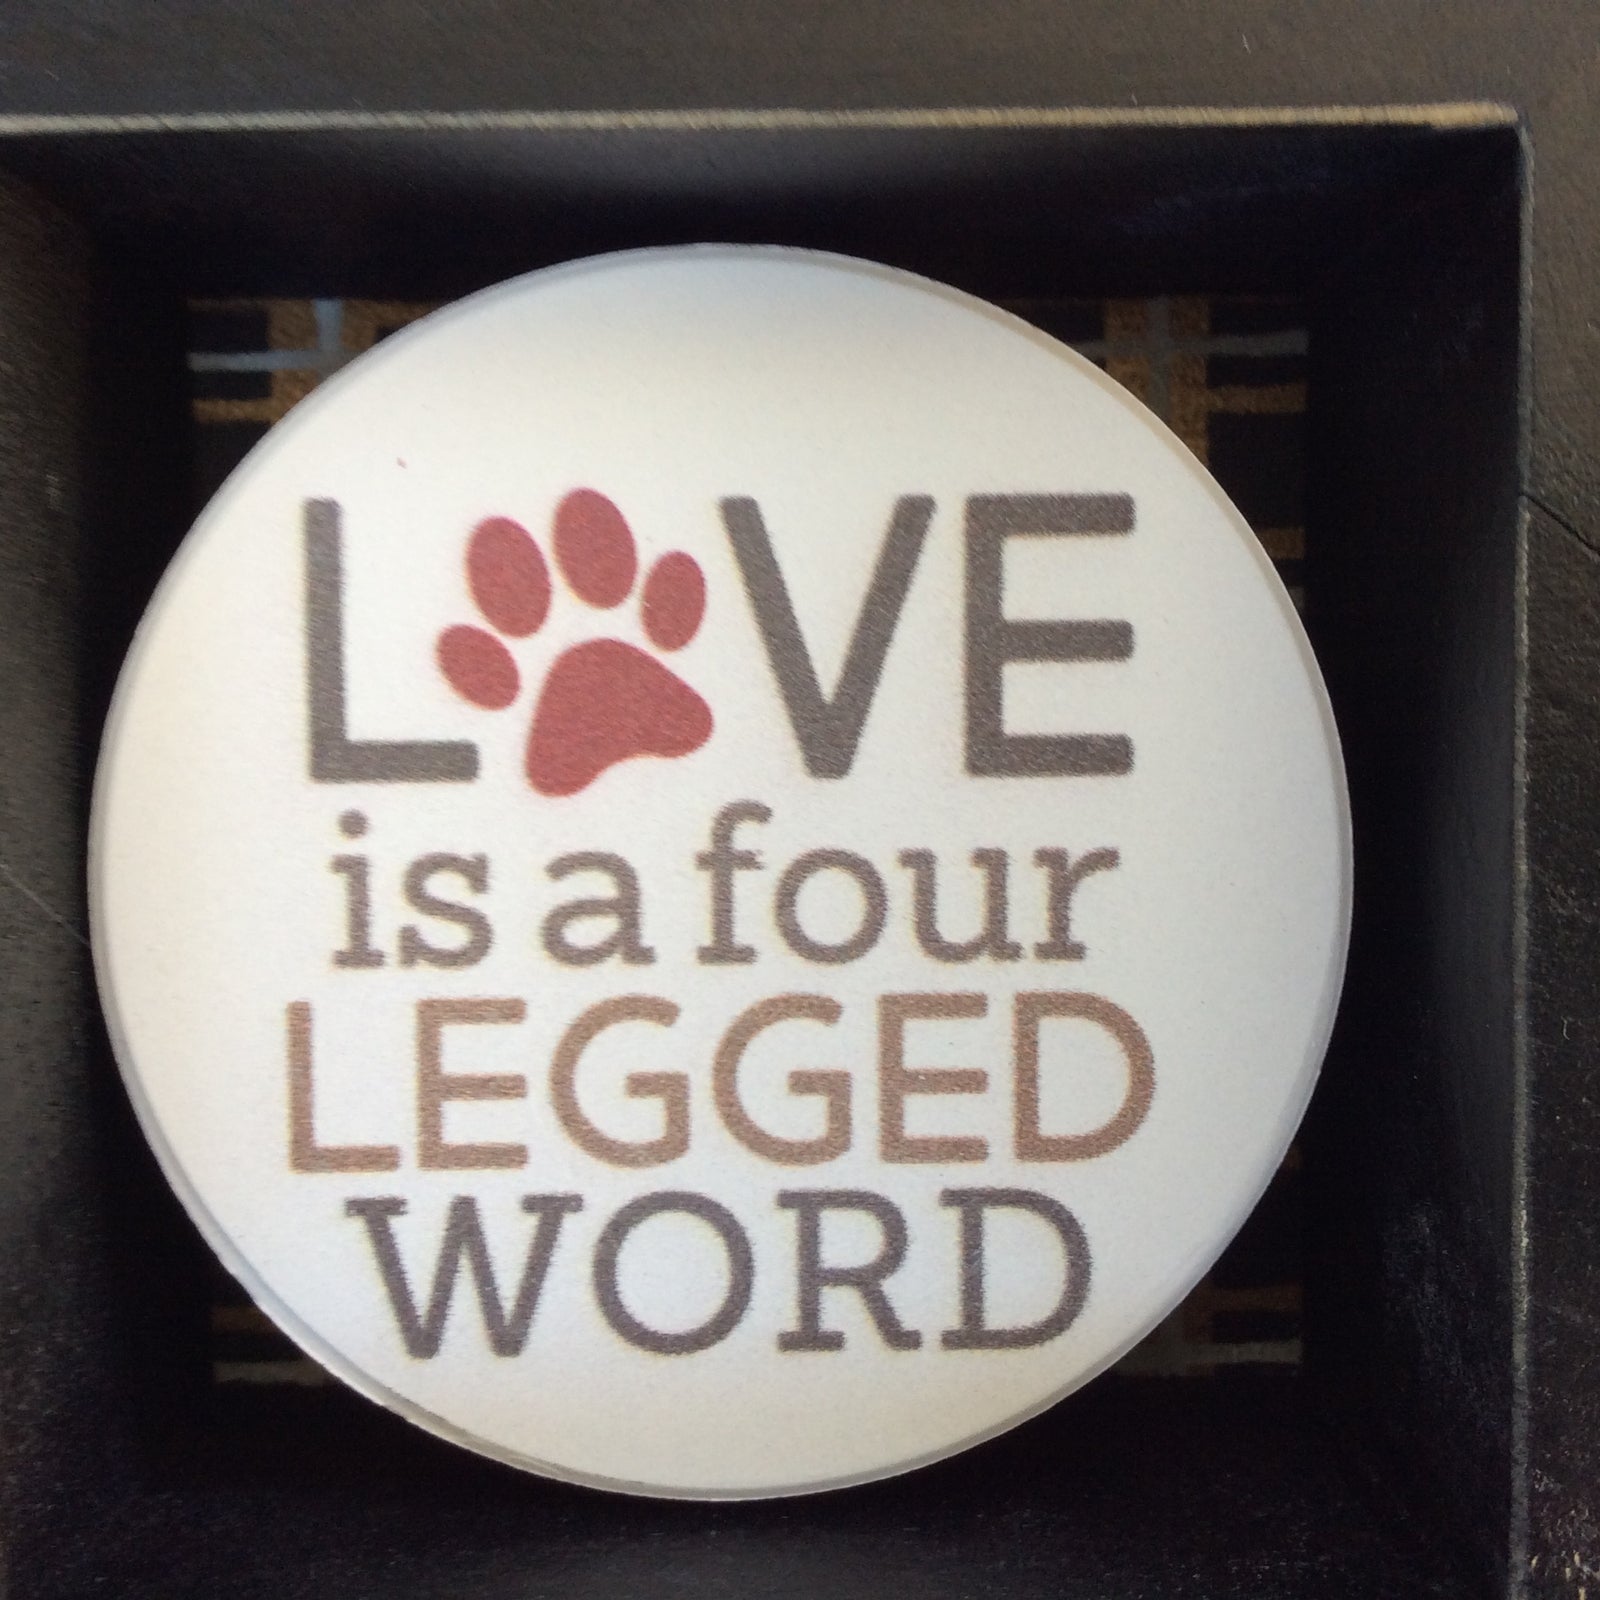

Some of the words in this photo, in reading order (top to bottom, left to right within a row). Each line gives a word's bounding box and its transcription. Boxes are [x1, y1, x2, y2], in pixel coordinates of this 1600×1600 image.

[301, 488, 1137, 798] LVE
[331, 811, 493, 970] is
[541, 851, 656, 969] a
[696, 801, 1122, 967] four
[286, 990, 1158, 1174] LEGGED
[344, 1186, 1094, 1361] WORD
